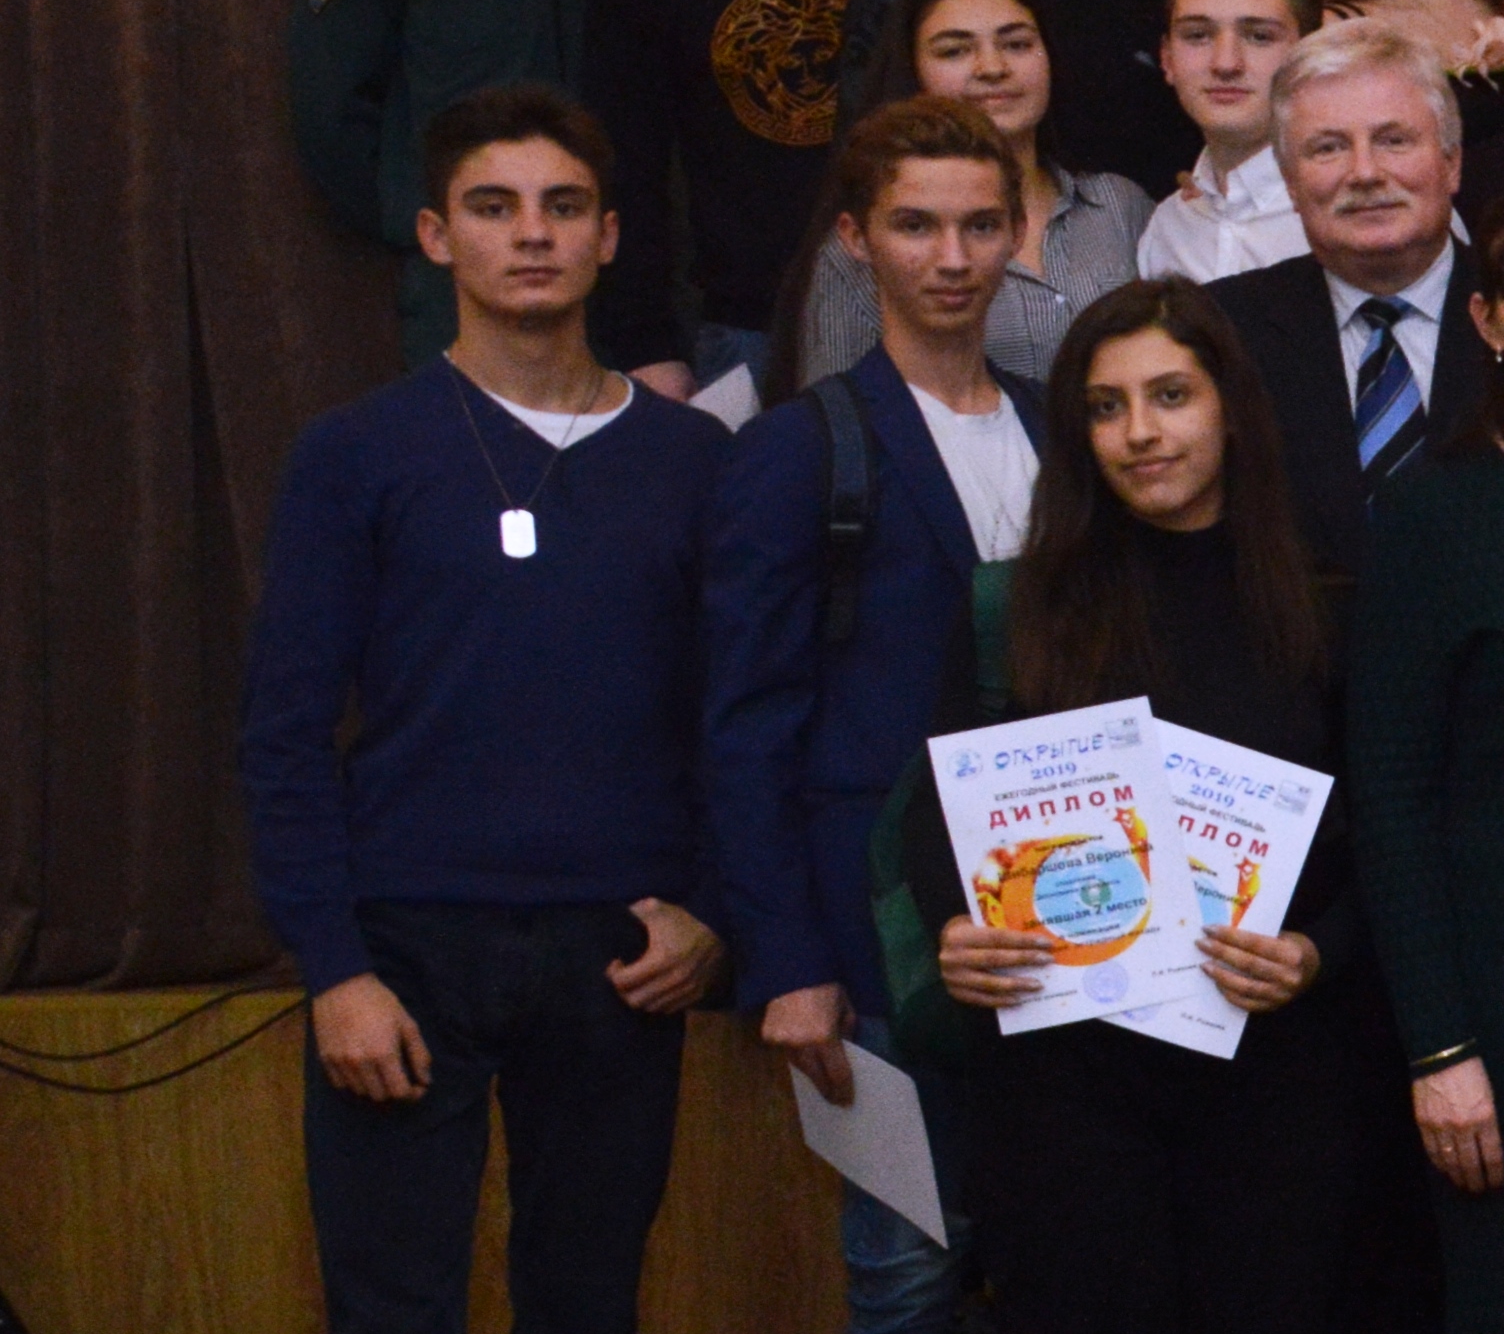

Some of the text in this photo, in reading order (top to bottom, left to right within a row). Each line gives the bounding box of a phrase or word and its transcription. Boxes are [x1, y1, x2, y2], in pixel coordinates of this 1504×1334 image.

[994, 734, 1105, 767] ОТКРЫТИЕ
[1031, 763, 1076, 780] 2019
[988, 785, 1134, 828] ДИПЛОМ
[1190, 784, 1234, 806] 2019
[1177, 815, 1269, 856] ПЛОМ
[1093, 903, 1102, 915] 2
[1107, 897, 1147, 910] место
